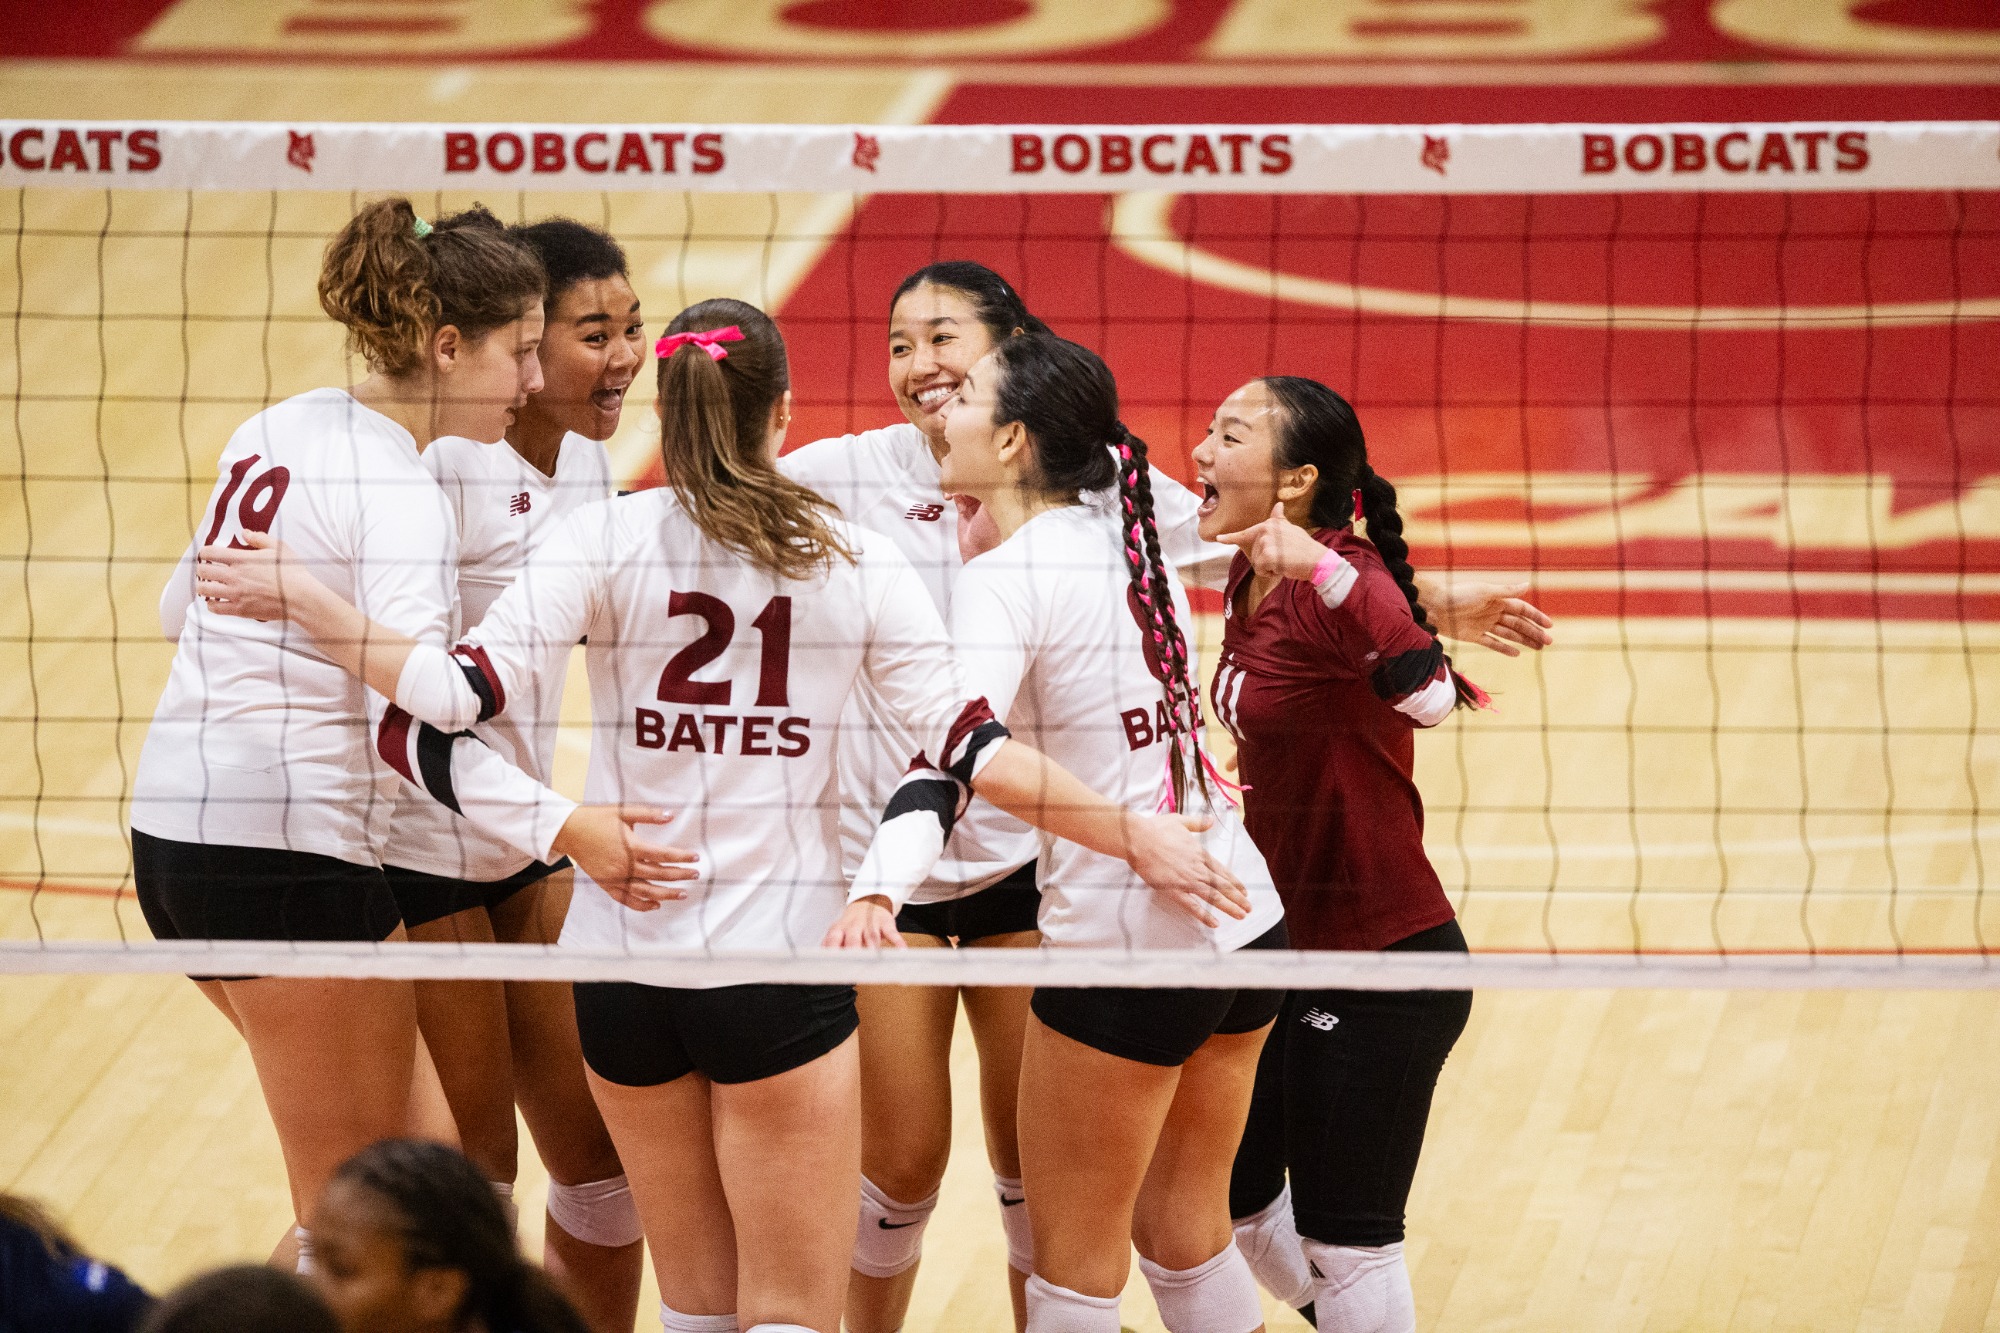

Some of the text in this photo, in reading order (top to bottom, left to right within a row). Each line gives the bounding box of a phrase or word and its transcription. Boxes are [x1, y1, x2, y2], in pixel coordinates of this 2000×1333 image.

[0, 129, 161, 171] CATS
[445, 133, 725, 174] BOBCATS
[1011, 134, 1293, 175] BOBCATS
[1582, 132, 1869, 174] BOBCATS
[204, 453, 290, 551] 19
[657, 590, 791, 706] 21
[1214, 652, 1247, 742] 11
[635, 707, 811, 758] BATES
